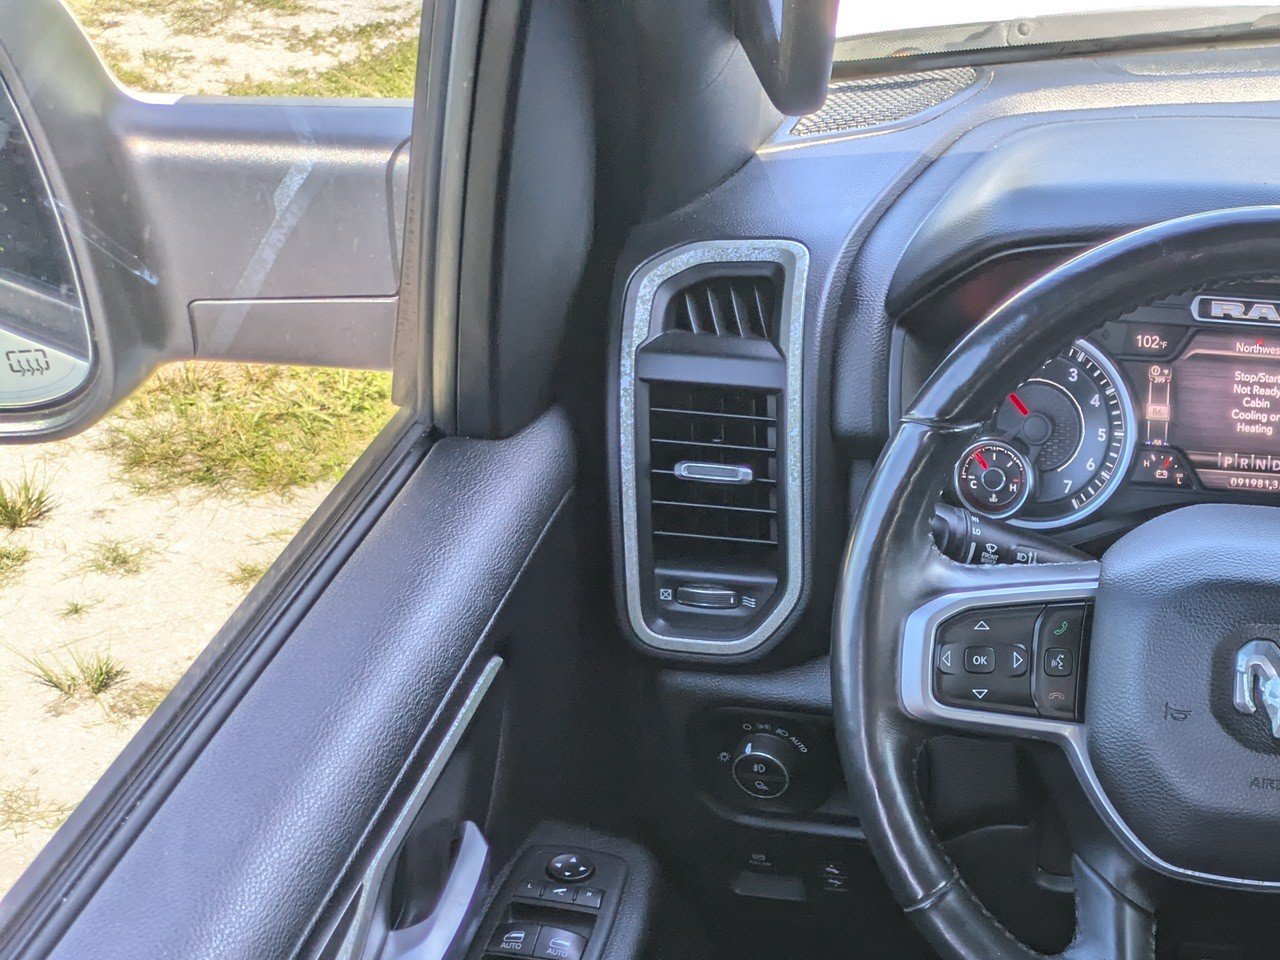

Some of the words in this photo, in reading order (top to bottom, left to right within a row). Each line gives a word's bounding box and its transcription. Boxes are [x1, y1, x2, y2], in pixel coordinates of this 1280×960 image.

[1068, 367, 1078, 382] 3
[1233, 384, 1251, 396] Not
[1090, 393, 1100, 408] 4
[1242, 397, 1271, 408] Cabin
[1231, 409, 1268, 423] Cooling
[1270, 413, 1280, 422] or
[1097, 428, 1107, 442] 5
[1236, 422, 1273, 436] Heating
[1086, 457, 1096, 471] 6
[1143, 459, 1150, 467] H
[1224, 456, 1233, 468] P
[1240, 458, 1249, 469] R
[1256, 459, 1266, 470] N
[970, 479, 978, 489] C
[1009, 484, 1017, 493] H
[1063, 479, 1073, 493] 7
[981, 551, 999, 561] FRONT
[972, 655, 988, 665] OK
[790, 736, 808, 753] AUTO
[500, 941, 522, 951] AUTO
[546, 948, 568, 957] AUTO
